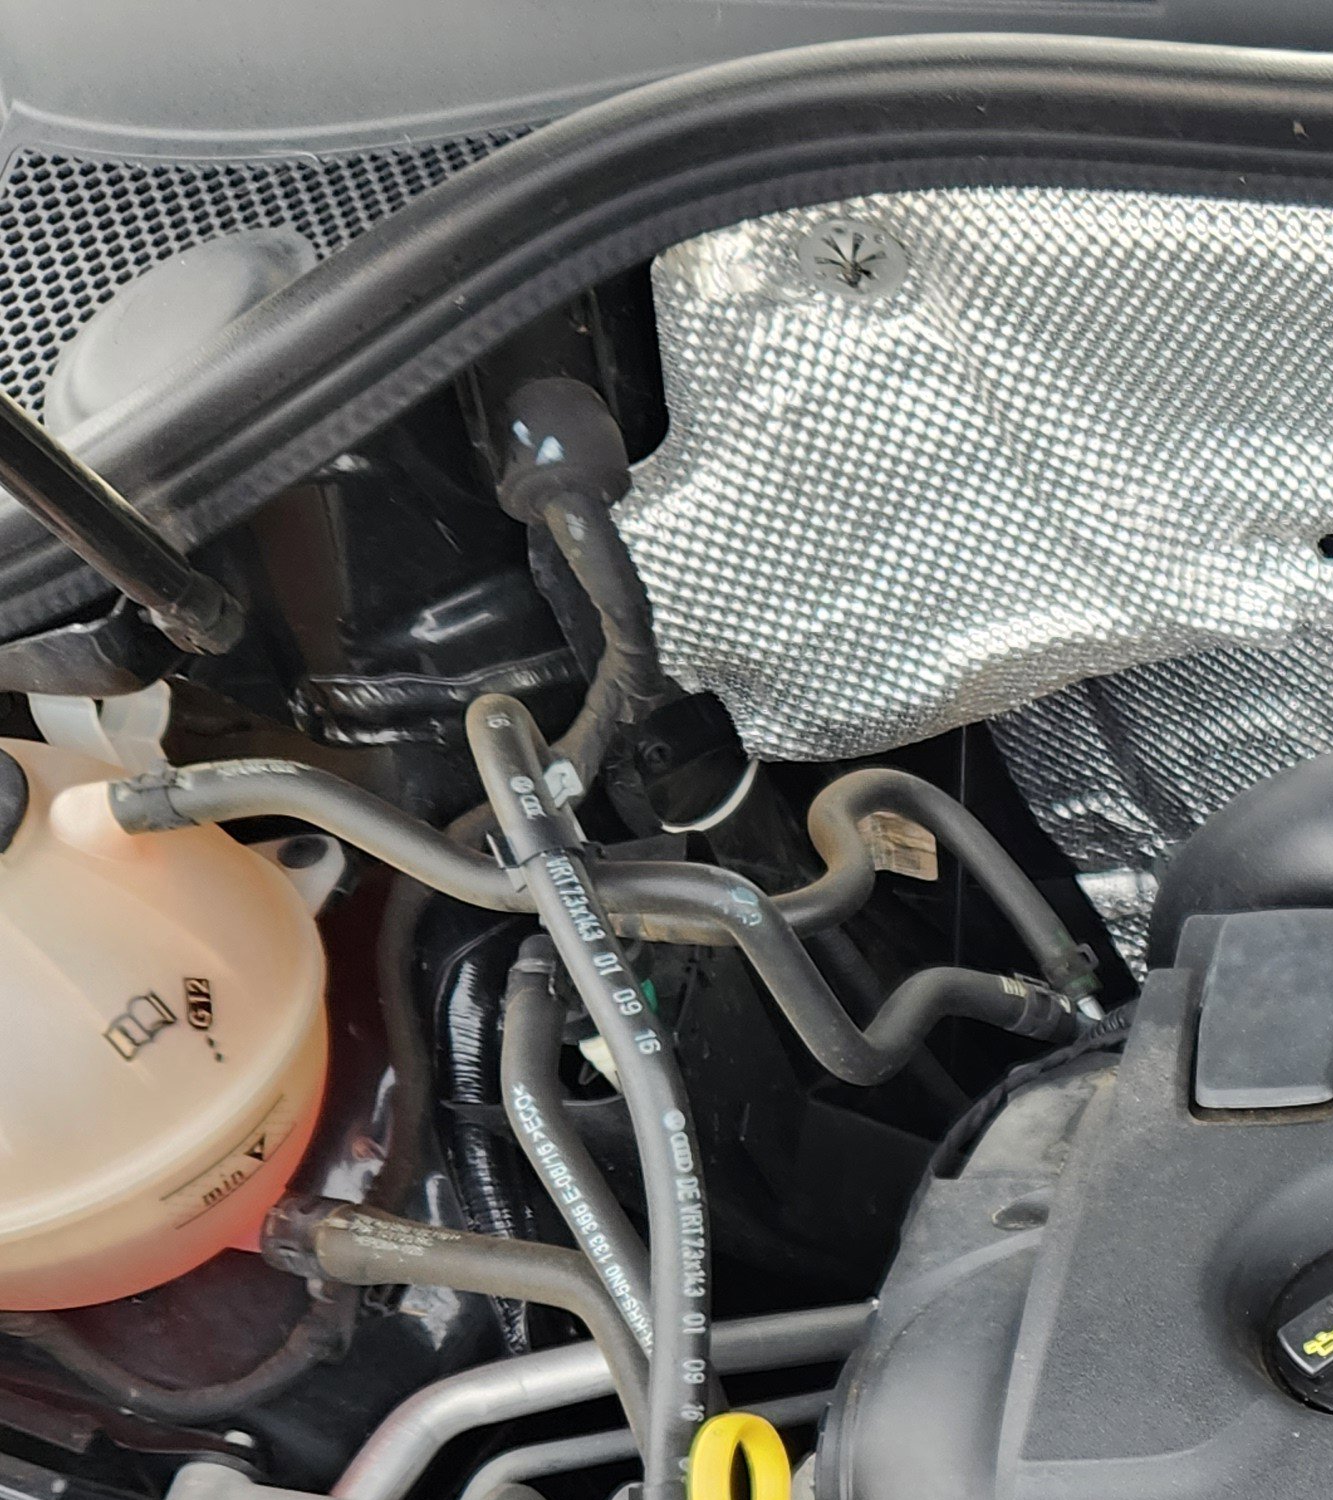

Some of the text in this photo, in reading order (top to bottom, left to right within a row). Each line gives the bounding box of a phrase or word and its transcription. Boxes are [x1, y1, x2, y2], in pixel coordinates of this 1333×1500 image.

[592, 952, 624, 976] 01
[612, 988, 643, 1016] 09
[634, 1028, 661, 1054] 16
[201, 1168, 247, 1206] min
[588, 1233, 613, 1263] 133
[682, 1312, 706, 1333] 01
[683, 1359, 706, 1384] 09
[680, 1403, 704, 1422] 16
